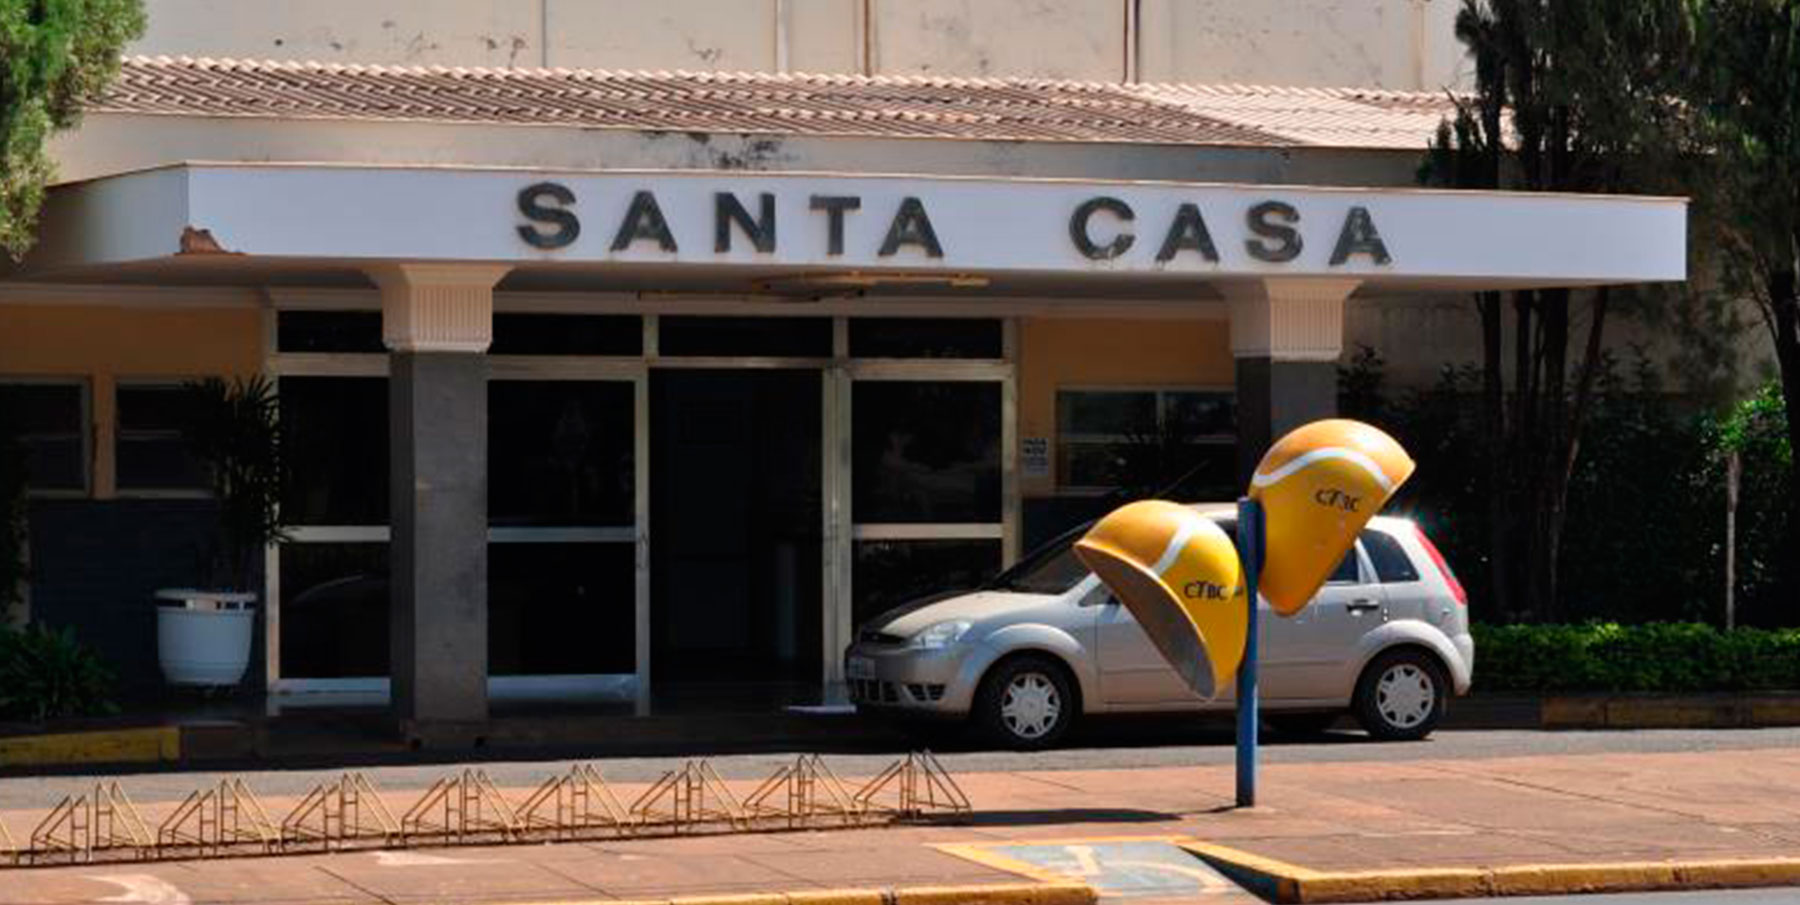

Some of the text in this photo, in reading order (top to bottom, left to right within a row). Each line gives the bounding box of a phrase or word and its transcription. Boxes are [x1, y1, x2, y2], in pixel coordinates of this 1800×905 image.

[516, 181, 1394, 266] SANTA CASA
[1183, 579, 1228, 601] CTBC
